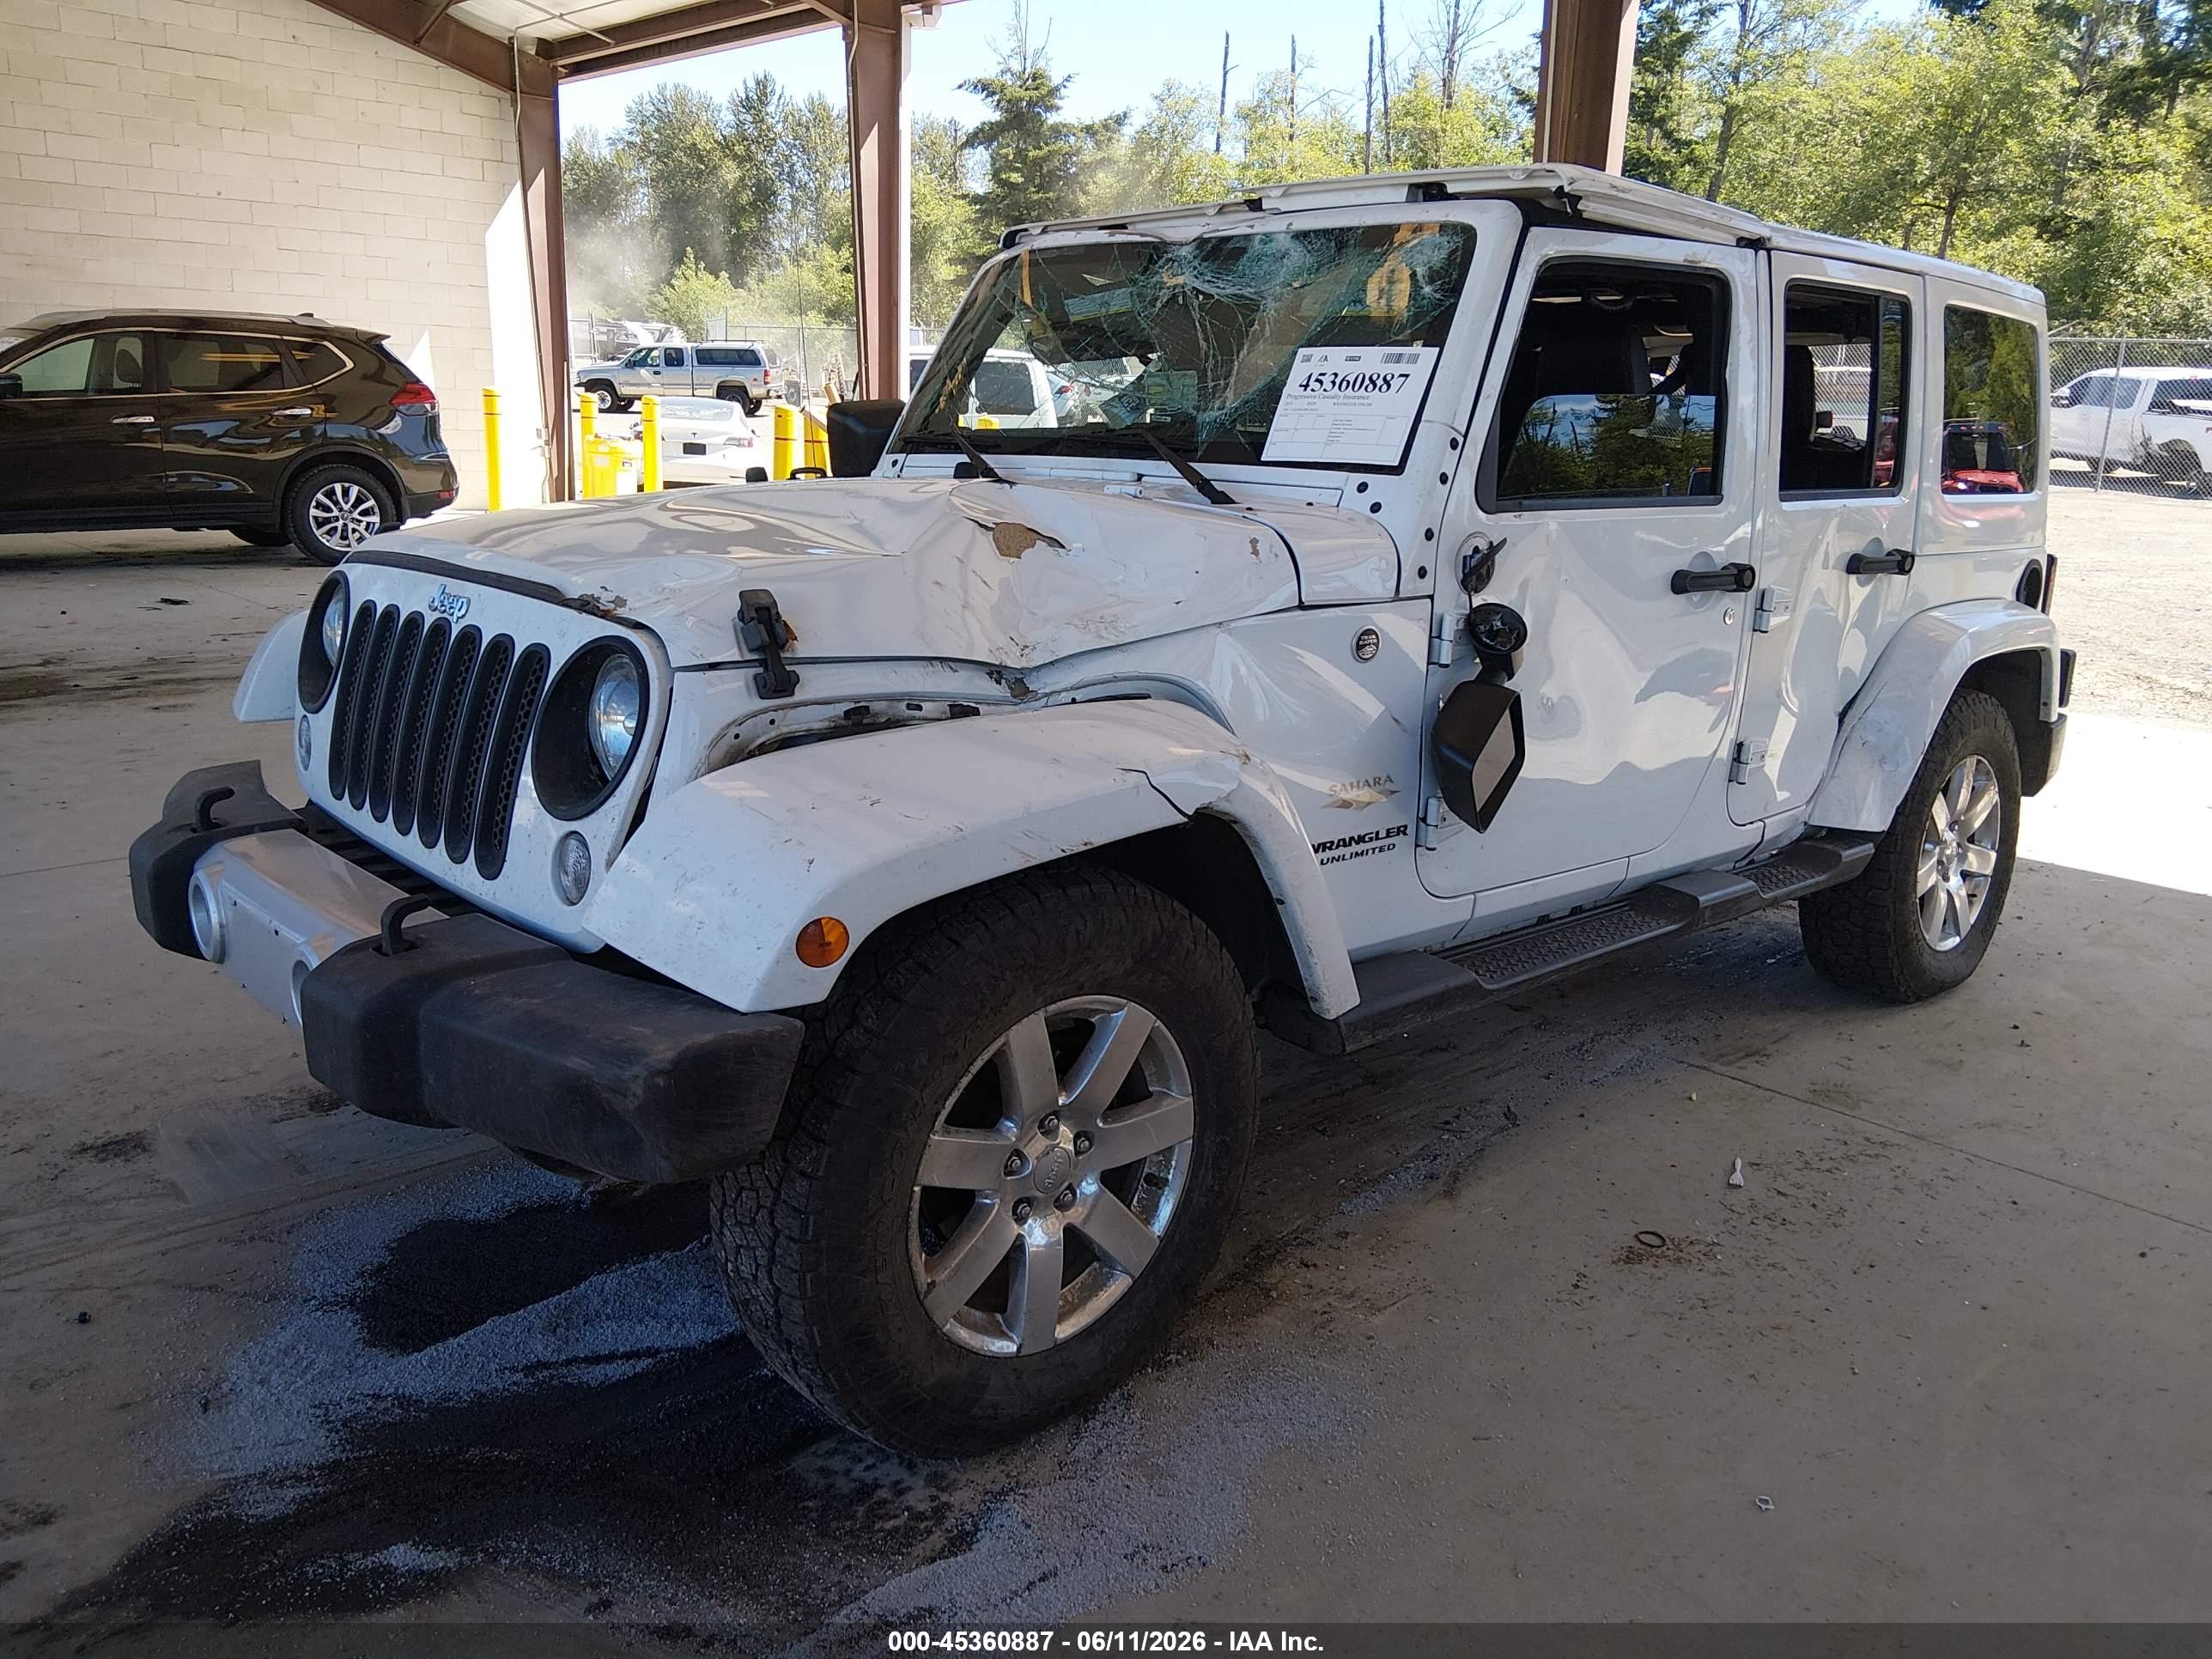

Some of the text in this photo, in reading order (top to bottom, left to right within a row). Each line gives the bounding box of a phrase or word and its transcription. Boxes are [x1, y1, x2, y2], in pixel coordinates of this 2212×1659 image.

[1298, 372, 1411, 394] 45360887
[428, 584, 471, 623] Jeep
[1329, 775, 1395, 796] SAHARA
[1320, 843, 1396, 866] UNLIMITED
